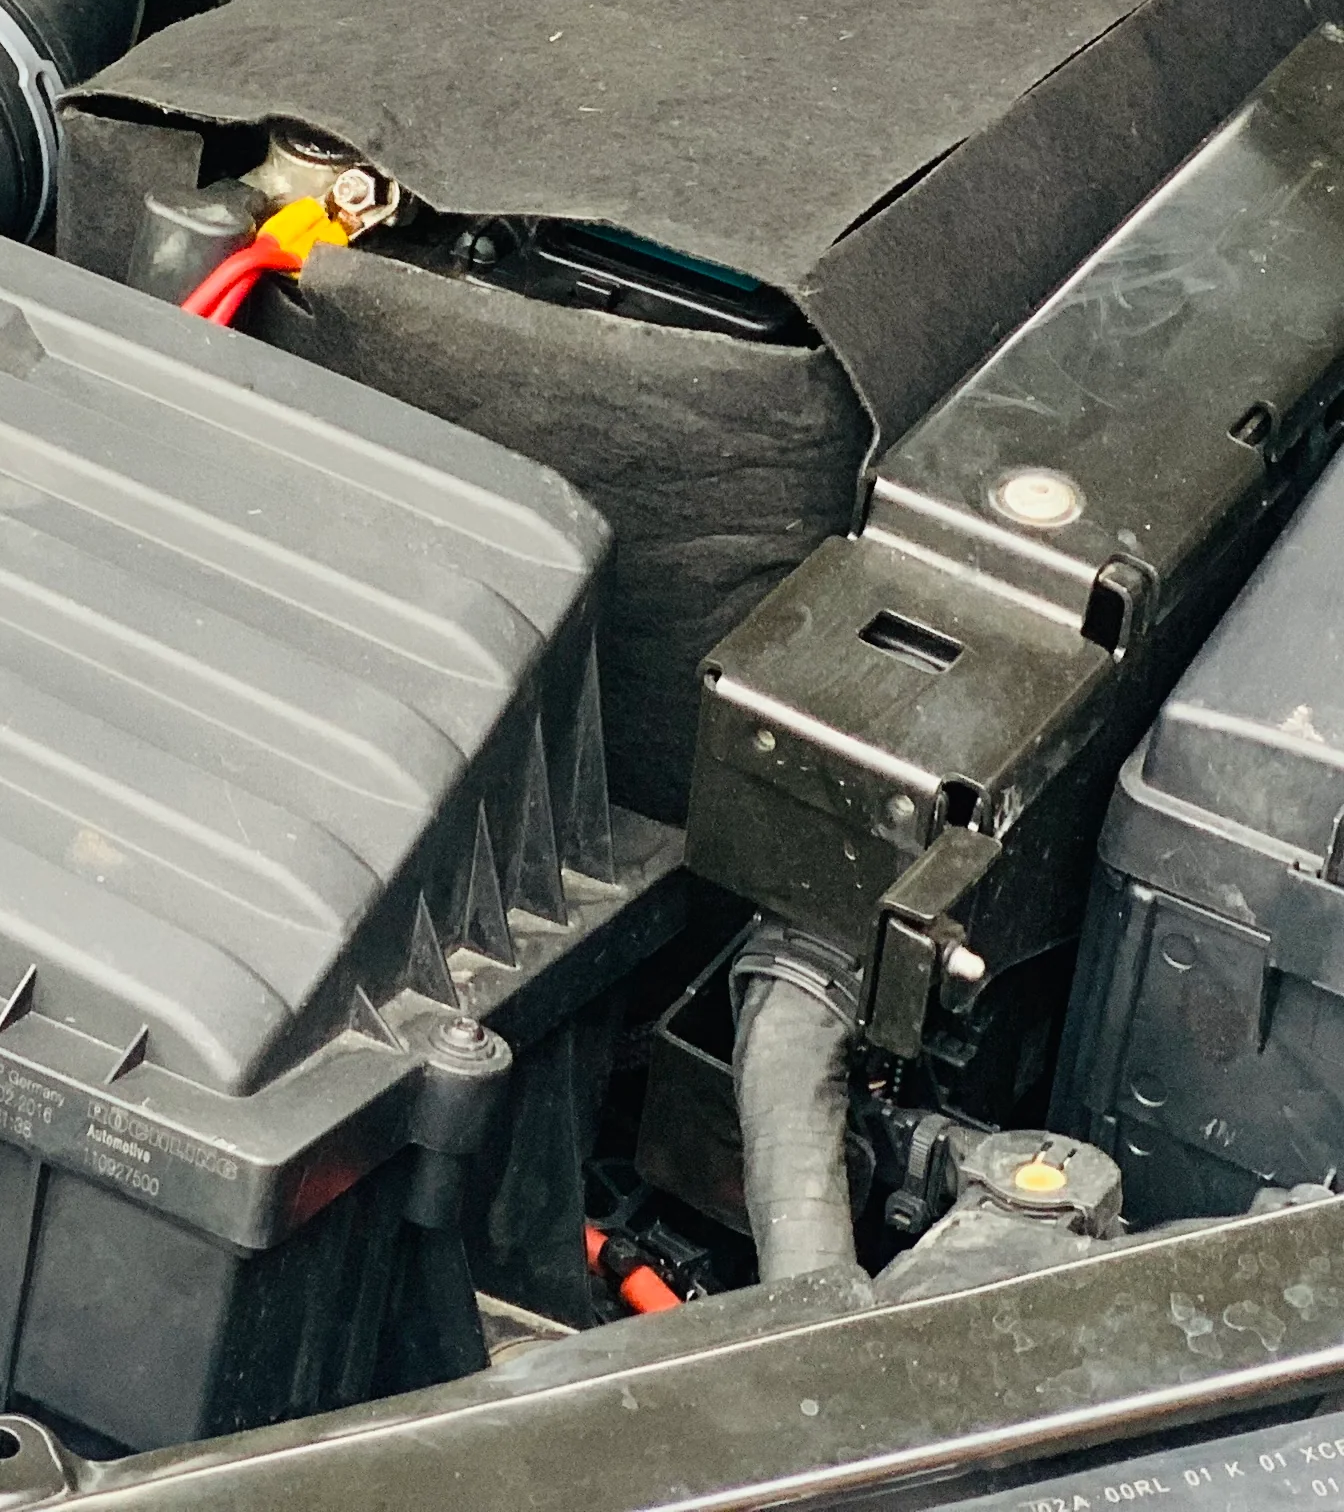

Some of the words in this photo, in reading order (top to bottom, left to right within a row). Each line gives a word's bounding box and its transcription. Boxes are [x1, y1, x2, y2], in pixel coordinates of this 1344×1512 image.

[8, 1069, 66, 1108] Germany
[86, 1124, 152, 1164] Automotive
[1104, 1478, 1172, 1505] 00RL
[1184, 1467, 1213, 1487] 01
[1225, 1461, 1245, 1478] K
[1259, 1452, 1287, 1473] 01
[1312, 1477, 1340, 1498] 01
